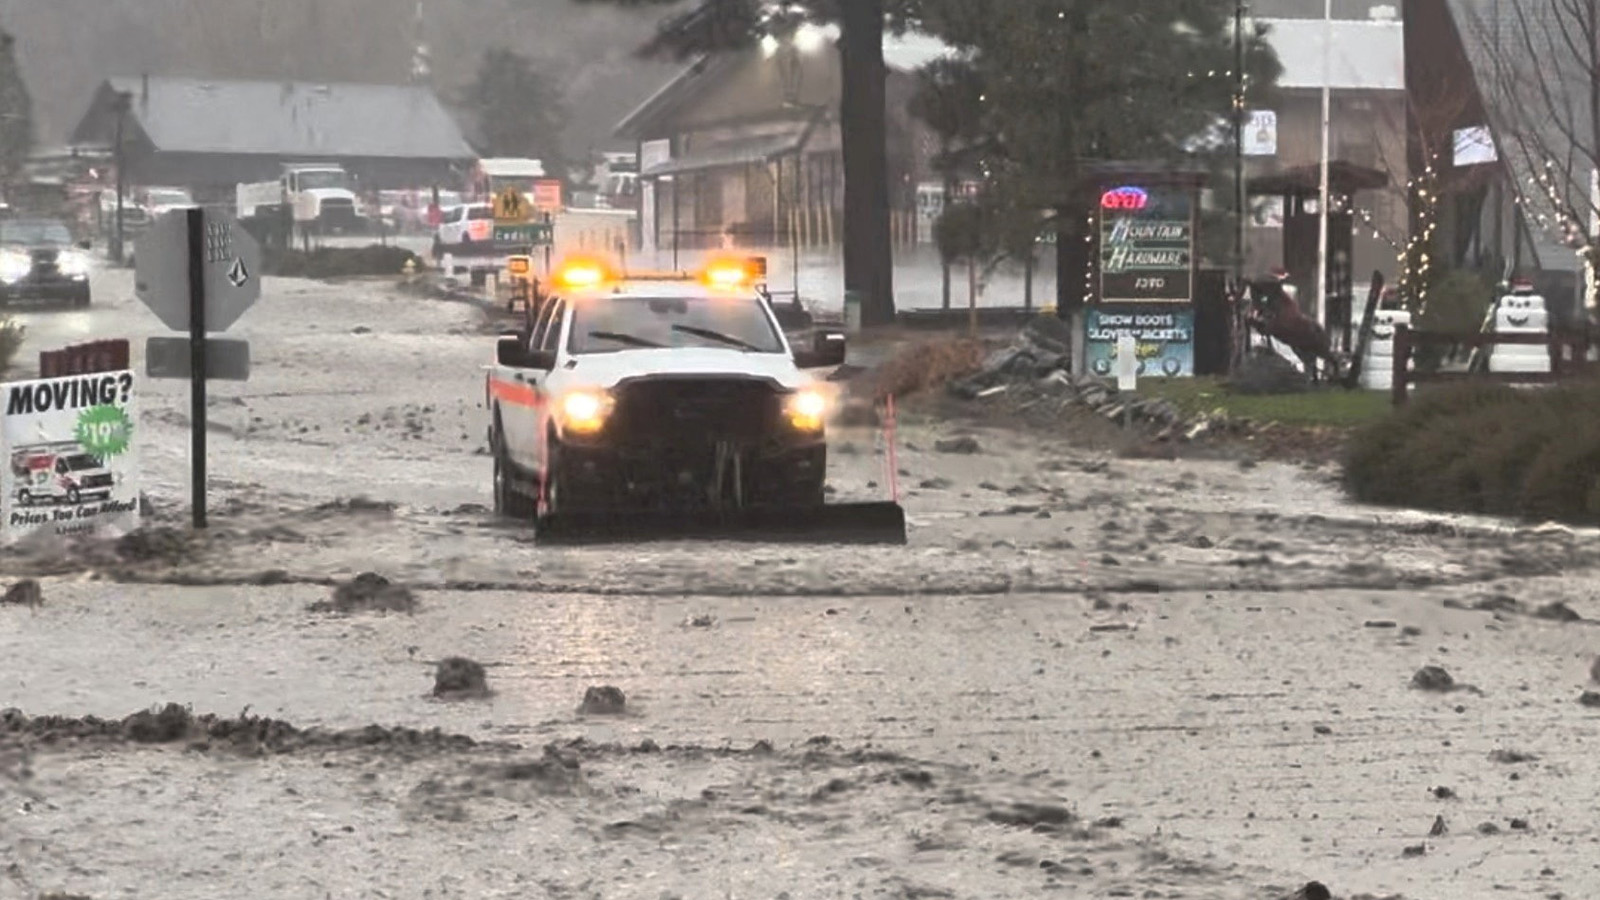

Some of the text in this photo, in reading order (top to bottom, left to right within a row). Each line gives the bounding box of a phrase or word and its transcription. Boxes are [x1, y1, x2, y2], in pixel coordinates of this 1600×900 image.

[1109, 218, 1183, 242] MOUNTAIN
[1107, 246, 1182, 269] HARDWARE
[1100, 314, 1173, 325] SNOW BOOTS
[1141, 327, 1188, 339] JACKETS
[7, 373, 133, 415] MOVING?
[11, 511, 48, 525] Prices
